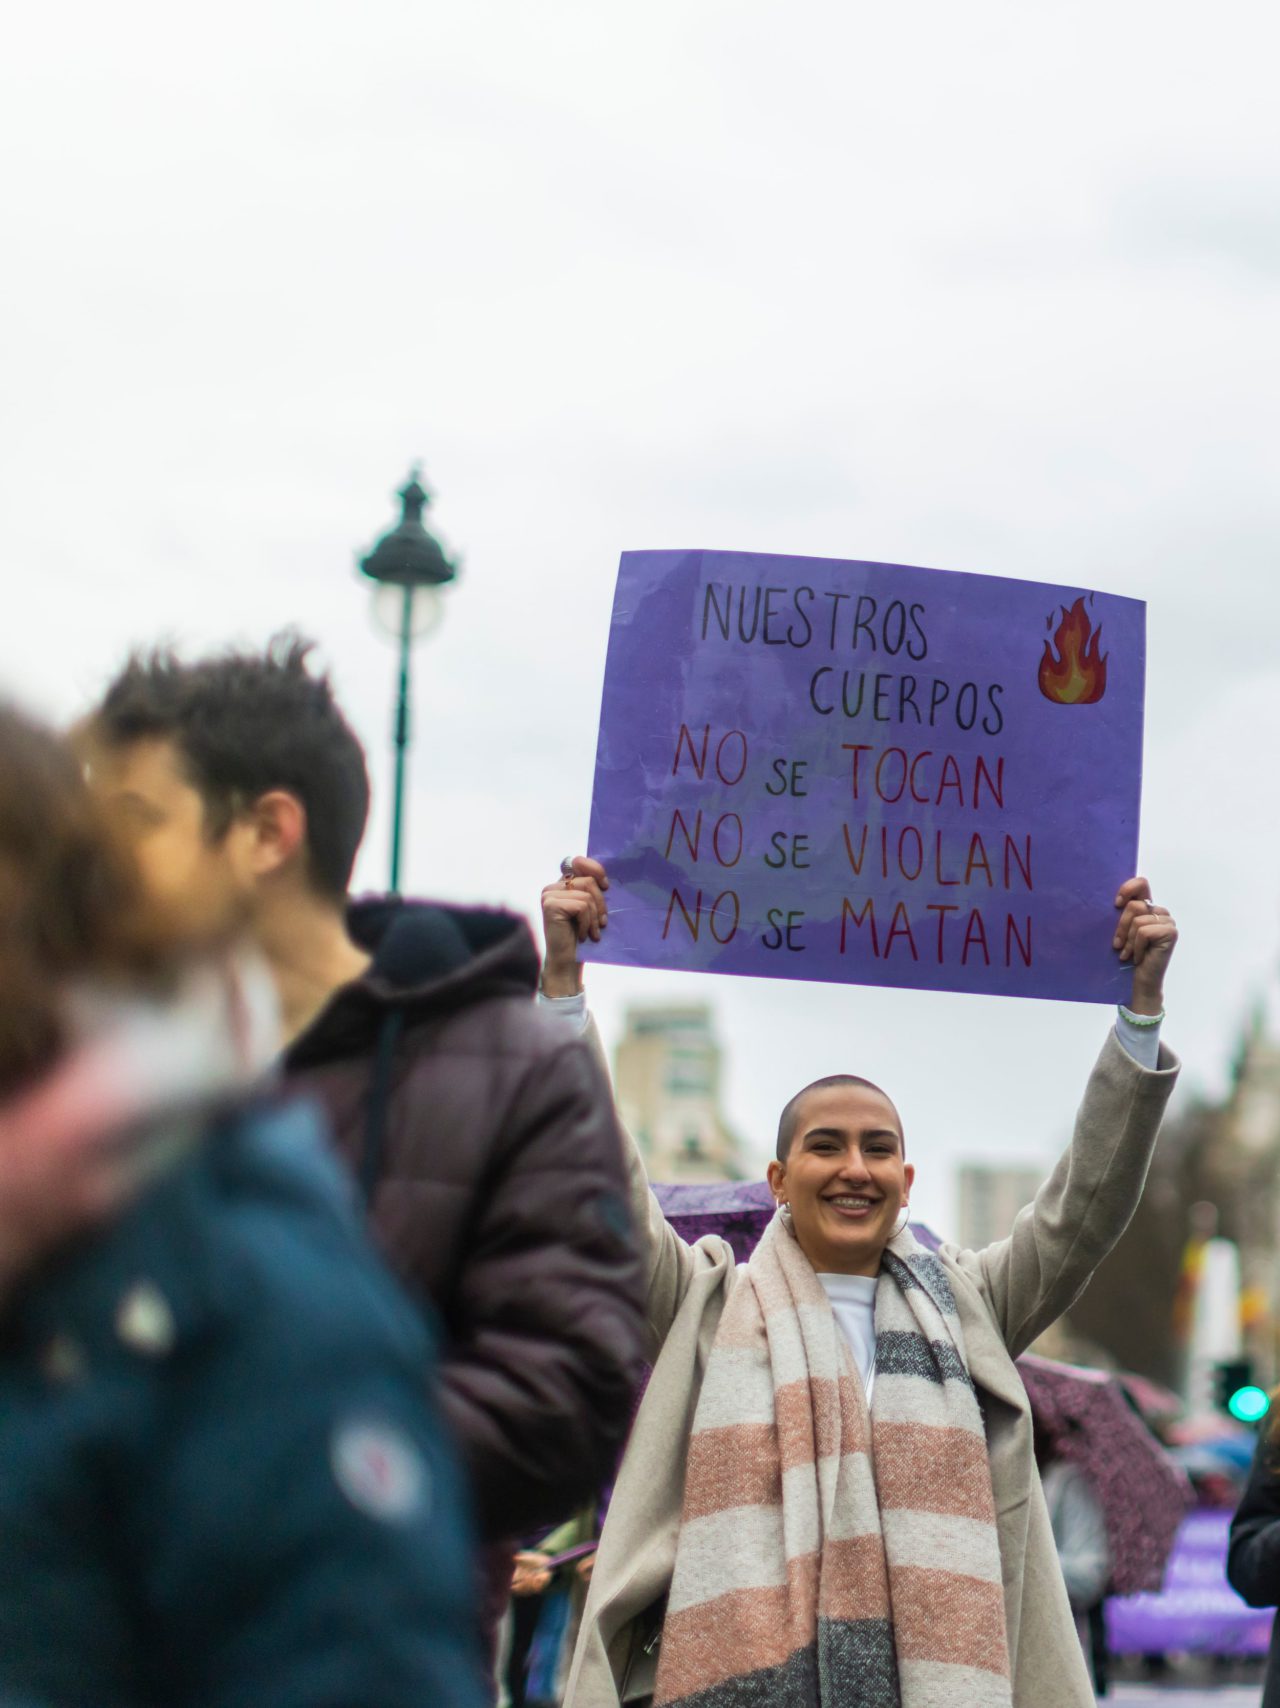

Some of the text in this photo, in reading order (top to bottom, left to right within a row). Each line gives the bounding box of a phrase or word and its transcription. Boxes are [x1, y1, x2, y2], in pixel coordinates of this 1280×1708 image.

[701, 583, 928, 660] NUESTROS
[809, 667, 1004, 735] CUERPOS
[673, 724, 1004, 810] NO SE TOCAN
[665, 809, 1033, 891] NO SE VIOLAN
[662, 889, 1032, 967] NO SE MATAN
